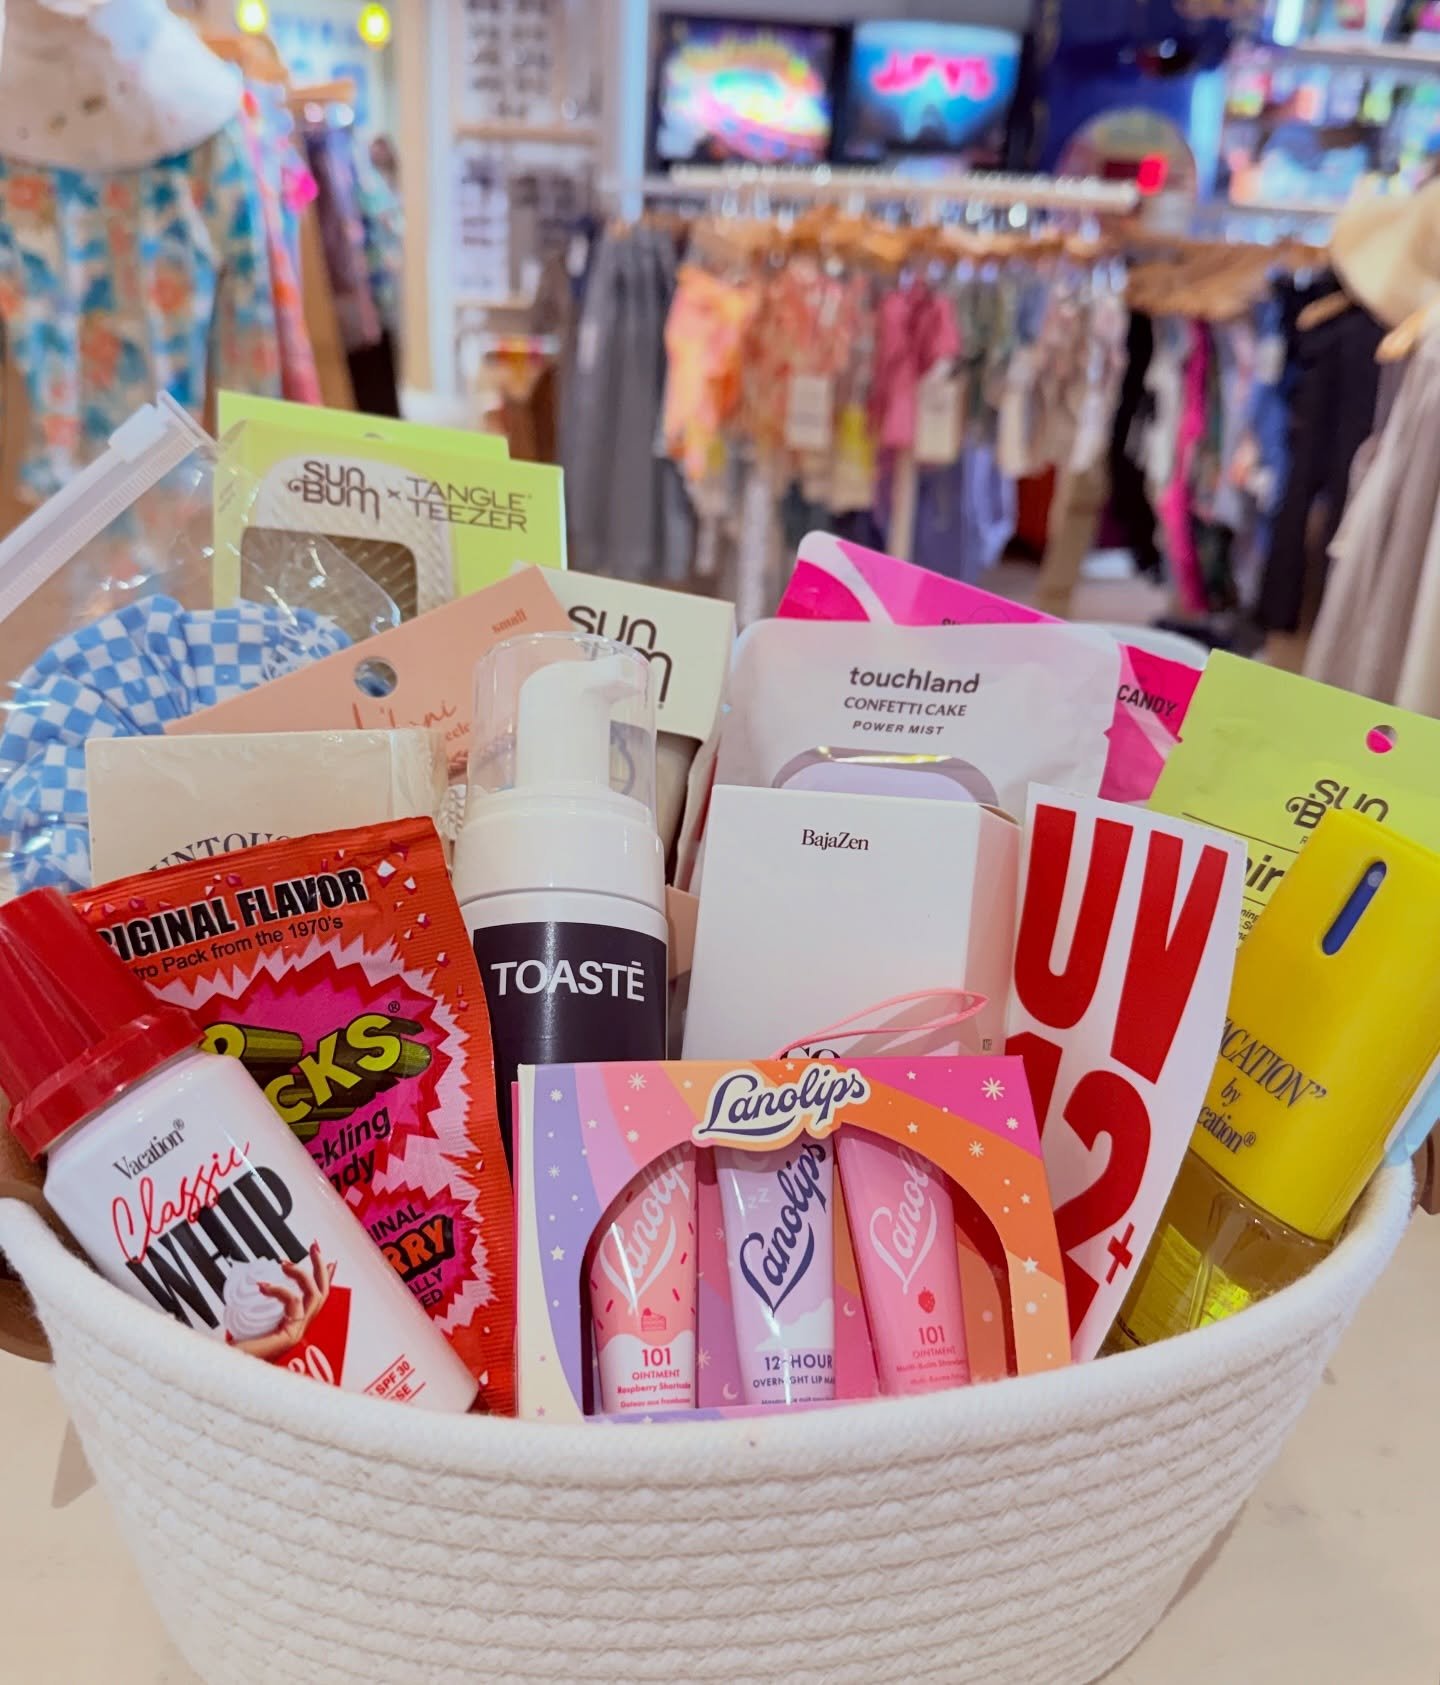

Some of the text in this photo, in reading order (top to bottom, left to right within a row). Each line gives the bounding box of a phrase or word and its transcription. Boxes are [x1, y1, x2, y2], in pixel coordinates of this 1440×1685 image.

[407, 497, 528, 534] TEEZER
[849, 666, 980, 694] touchland
[844, 696, 967, 717] CONFETTI CAKE
[1117, 684, 1178, 717] CANDY
[852, 720, 945, 736] POWER MIST
[801, 828, 869, 850] BajaZen
[235, 867, 369, 928] FLAVOR
[161, 946, 209, 974] Pack
[211, 938, 253, 961] from
[255, 928, 284, 947] the
[288, 915, 344, 940] 1970's
[1014, 803, 1228, 1084] UV
[698, 1067, 866, 1137] Lanolips
[1220, 1077, 1242, 1107] by
[112, 1141, 250, 1264] Classic
[739, 1142, 827, 1318] Lanolips
[125, 1166, 310, 1330] WHIP
[918, 1325, 945, 1345] 101
[641, 1347, 672, 1368] 101
[375, 1360, 410, 1396] SPF 30
[632, 1368, 681, 1381] OINTMENT
[811, 1375, 823, 1384] LIP
